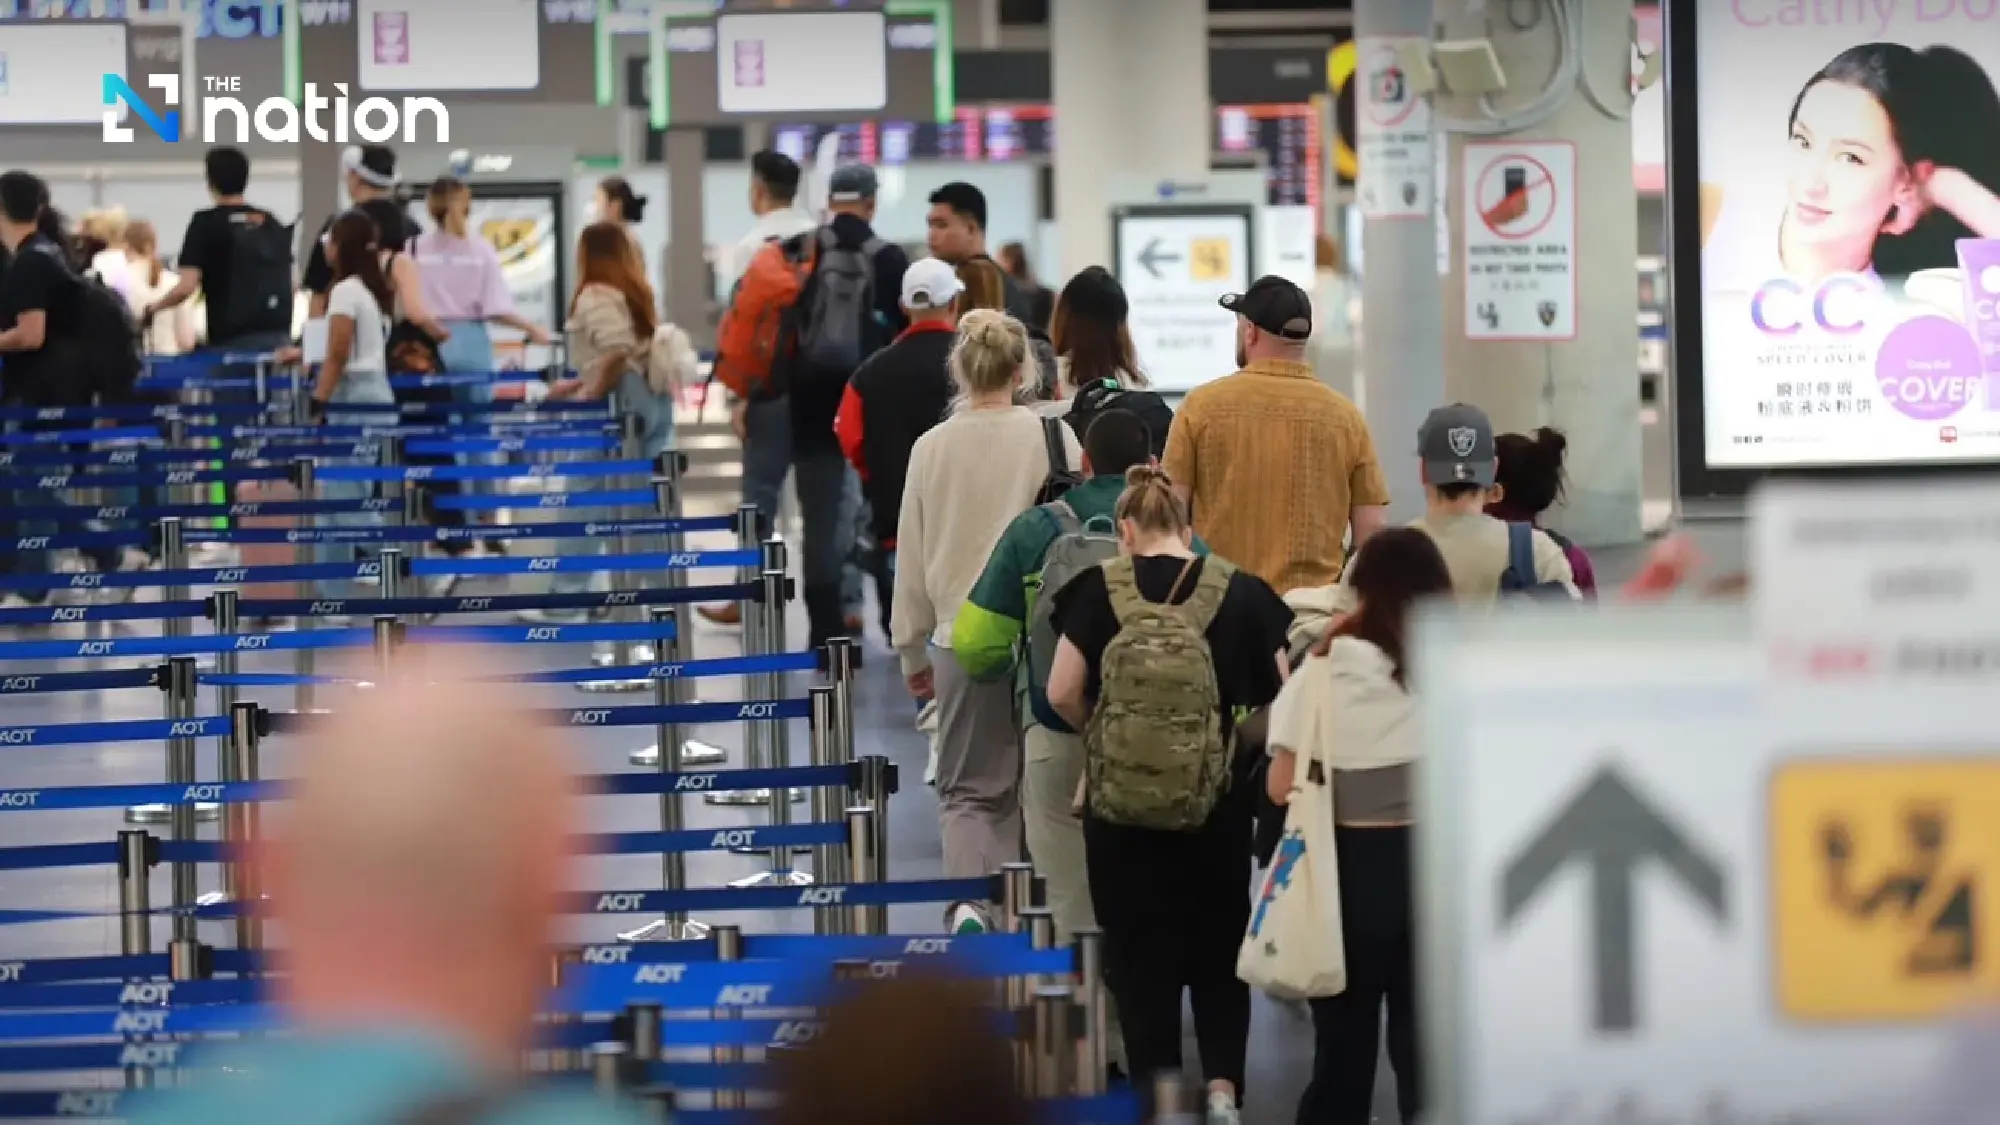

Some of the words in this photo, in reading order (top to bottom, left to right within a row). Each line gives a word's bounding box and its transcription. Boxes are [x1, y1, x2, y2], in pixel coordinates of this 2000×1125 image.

[1732, 0, 1893, 38] Cathy
[1750, 277, 1866, 334] CC
[17, 536, 51, 549] AOT
[527, 558, 560, 571] AOT
[667, 553, 701, 566] AOT
[70, 574, 105, 587] AOT
[213, 568, 248, 582] AOT
[458, 598, 492, 609] AOT
[605, 592, 639, 604] AOT
[51, 608, 87, 620] AOT
[309, 601, 345, 614] AOT
[525, 627, 561, 640] AOT
[77, 641, 114, 654] AOT
[234, 636, 271, 648] AOT
[648, 665, 683, 677] AOT
[2, 676, 41, 689] AOT
[571, 710, 611, 723] AOT
[738, 703, 778, 717] AOT
[170, 720, 209, 734] AOT
[0, 728, 36, 743] AOT
[674, 774, 718, 789] AOT
[0, 792, 40, 806] AOT
[182, 785, 225, 799] AOT
[711, 830, 757, 847] AOT
[597, 893, 646, 910] AOT
[797, 887, 847, 904] AOT
[904, 938, 952, 954] AOT
[583, 945, 633, 964] AOT
[633, 963, 688, 983] AOT
[119, 983, 175, 1003] AOT
[716, 984, 774, 1006] AOT
[114, 1009, 170, 1032] AOT
[118, 1041, 181, 1067] AOT
